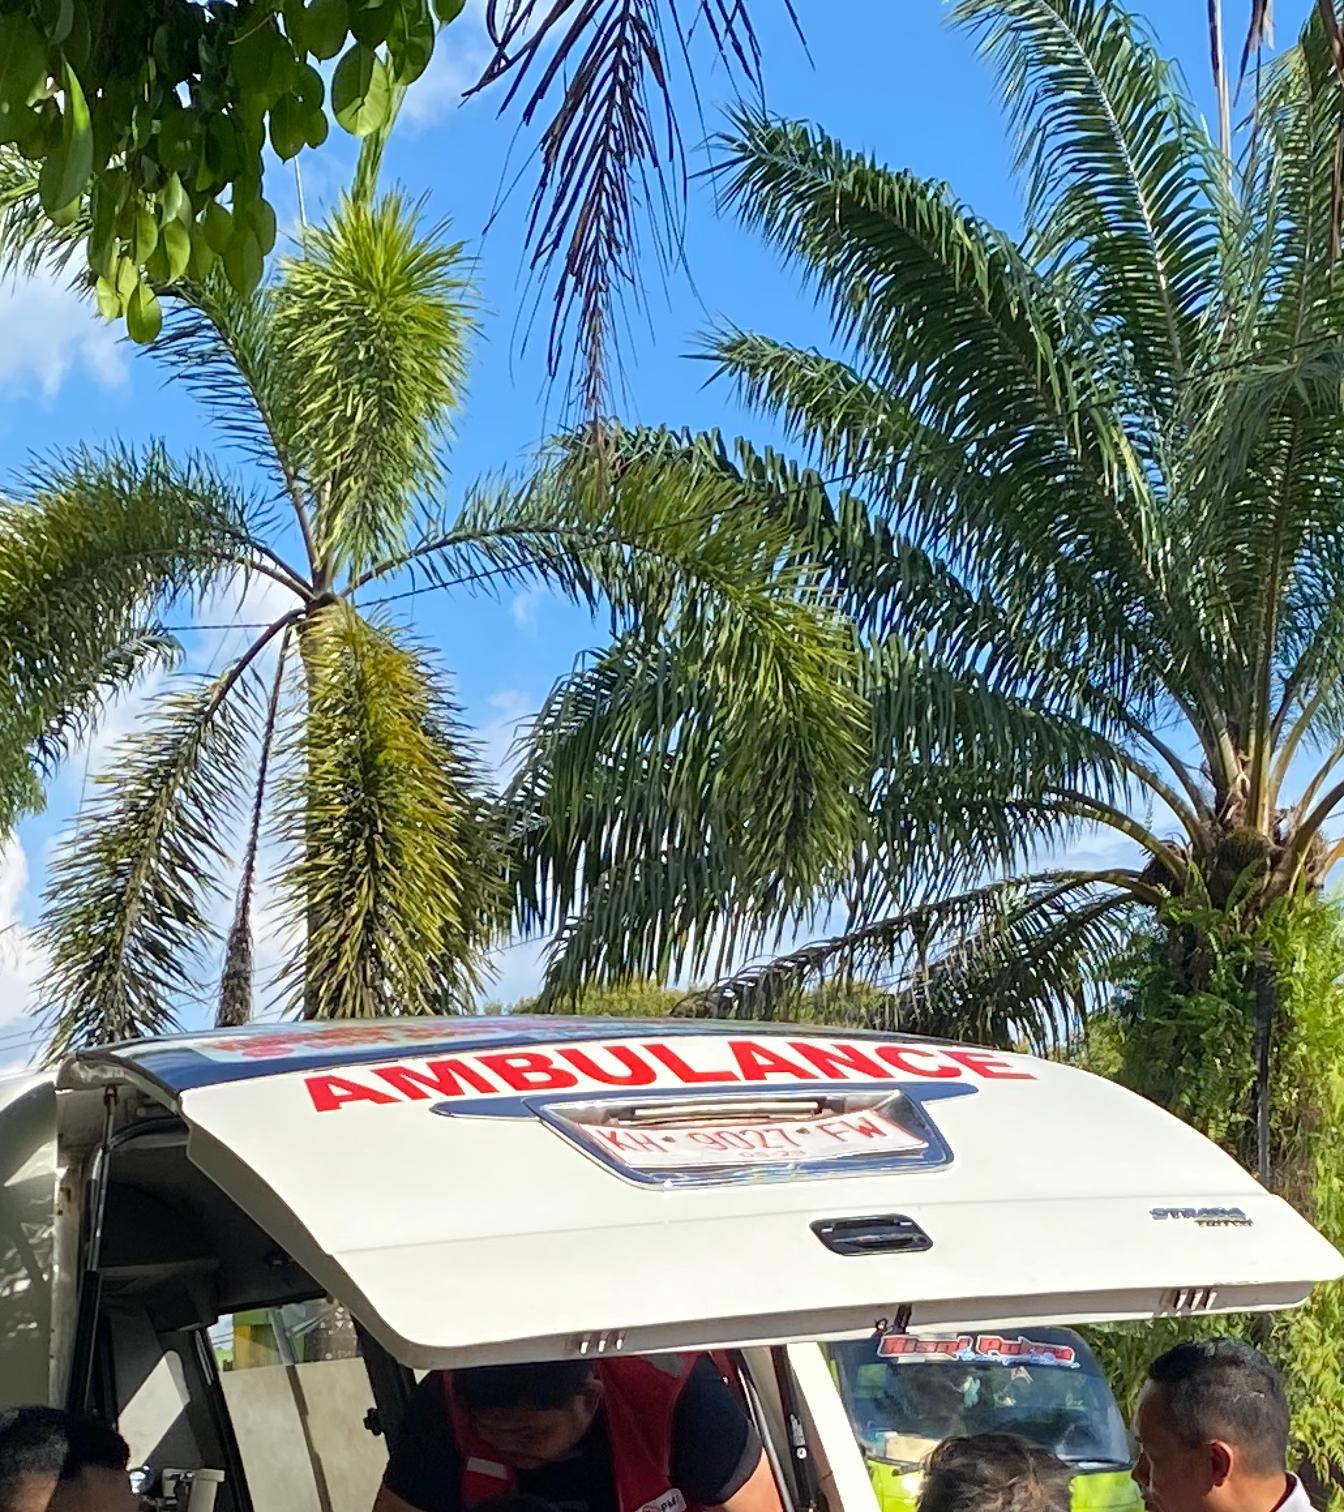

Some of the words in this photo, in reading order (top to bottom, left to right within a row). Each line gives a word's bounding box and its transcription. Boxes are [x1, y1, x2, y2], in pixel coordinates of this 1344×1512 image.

[304, 1041, 1038, 1112] AMBULANCE
[596, 1129, 670, 1152] KH
[688, 1128, 800, 1151] 9027
[817, 1117, 887, 1142] FW
